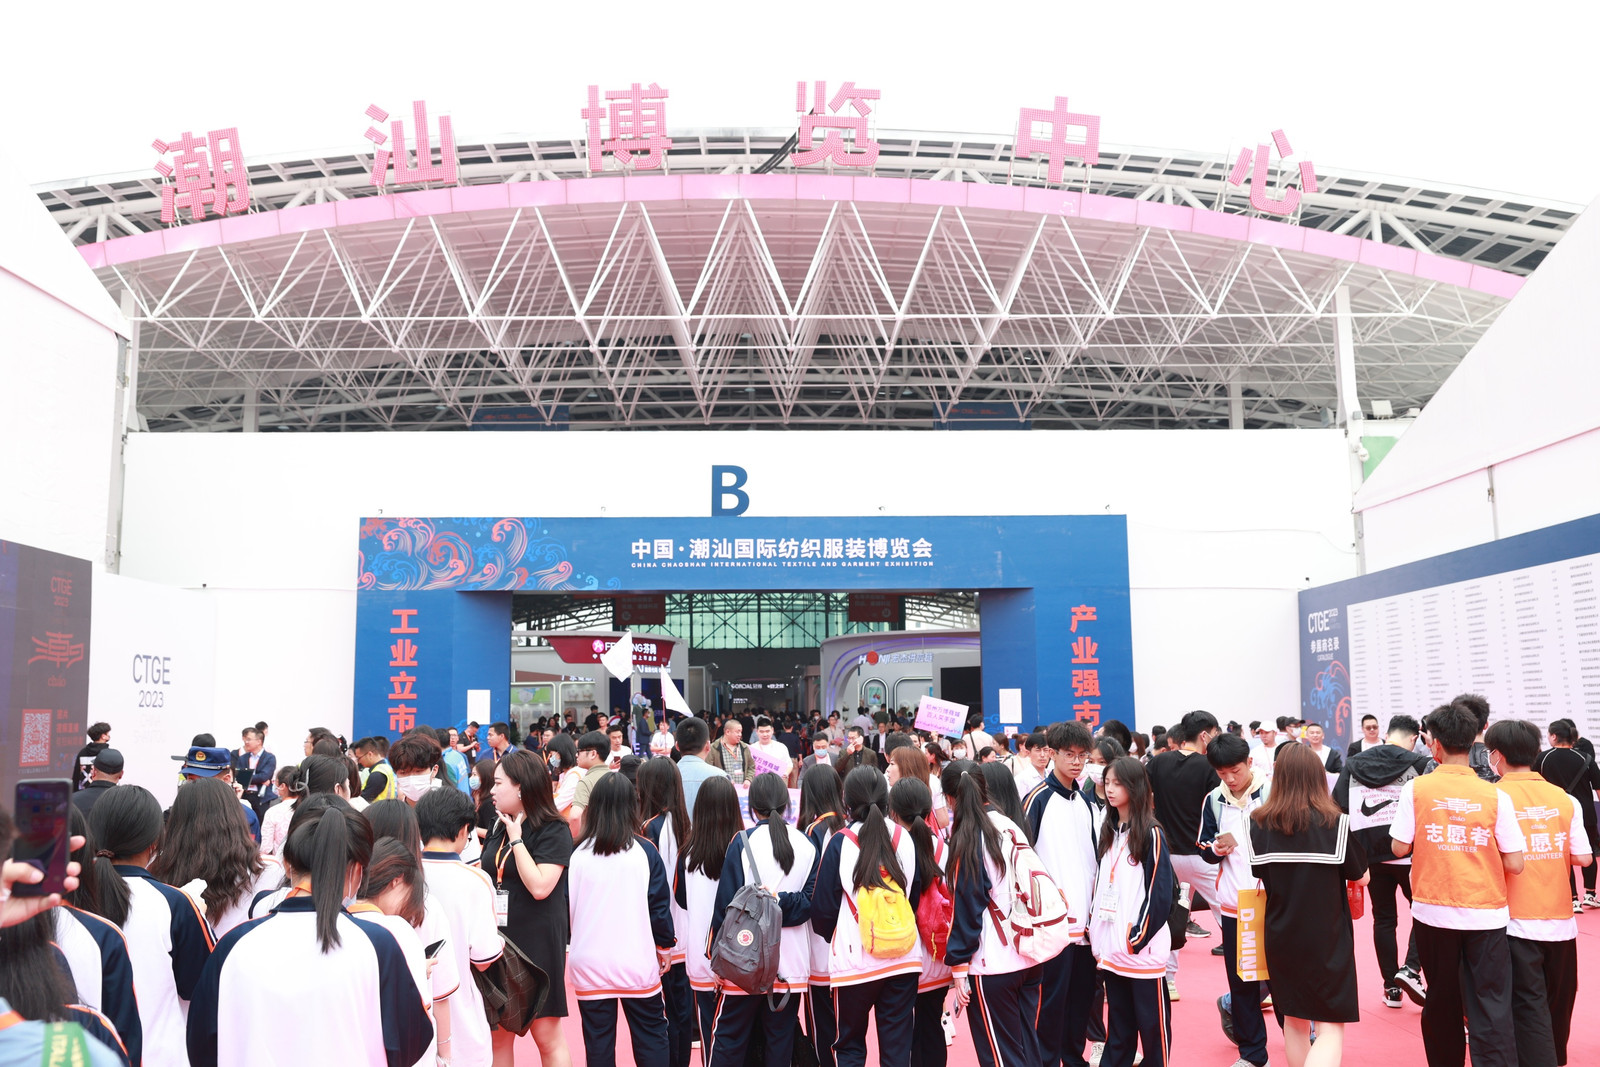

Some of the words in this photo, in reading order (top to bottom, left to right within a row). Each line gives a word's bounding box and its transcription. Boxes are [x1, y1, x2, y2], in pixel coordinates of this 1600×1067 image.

[152, 80, 1318, 222] 潮汕博览中心
[711, 465, 750, 517] B
[631, 537, 933, 559] 中国·潮汕国际纺织服装博览会
[50, 577, 72, 596] CTGE
[1308, 610, 1330, 633] CTGE
[133, 654, 171, 685] CTGE
[387, 609, 419, 733] 工业立市
[1069, 604, 1101, 727] 产业强市
[139, 690, 164, 708] 2023
[1424, 823, 1491, 847] 志愿者
[1437, 844, 1478, 853] VOLUNTEER
[1240, 908, 1257, 982] D-MIND
